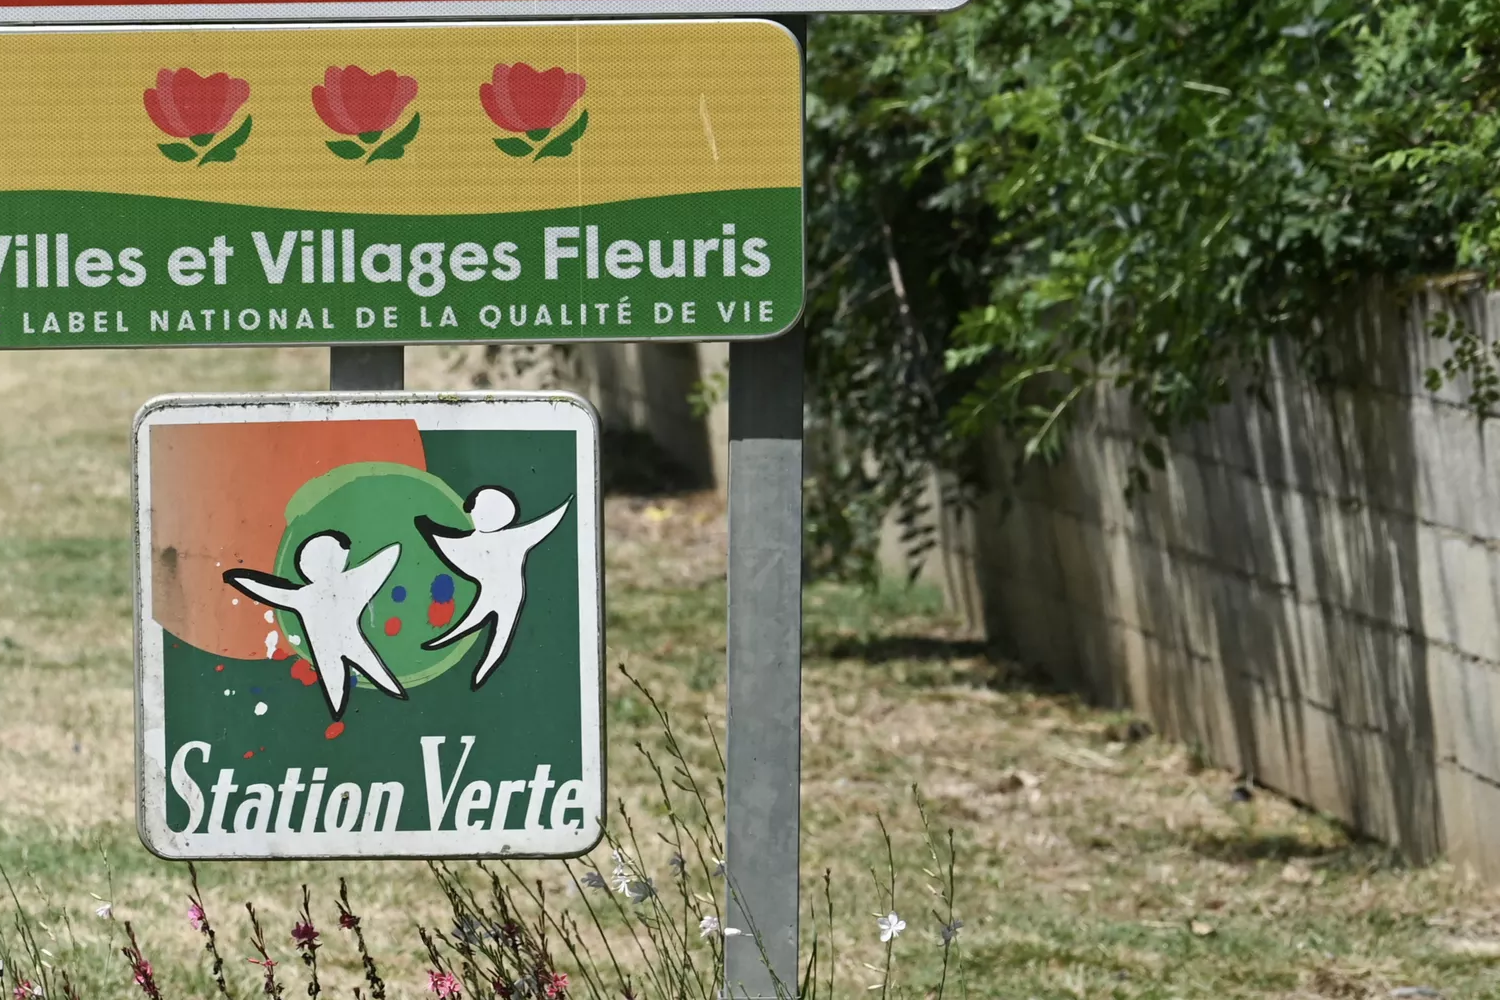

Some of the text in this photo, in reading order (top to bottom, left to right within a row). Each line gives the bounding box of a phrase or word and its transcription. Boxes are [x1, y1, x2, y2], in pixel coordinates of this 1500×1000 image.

[167, 236, 234, 287] et
[250, 228, 522, 298] Villages
[544, 223, 771, 281] Fleuris
[22, 310, 129, 334] LABEL
[150, 306, 332, 332] NATIONAL
[355, 306, 398, 329] DE
[420, 305, 460, 328] LA
[478, 296, 632, 330] QUALITÉ
[653, 301, 697, 324] DE
[716, 300, 775, 324] VIE
[170, 735, 586, 834] Station Verte
